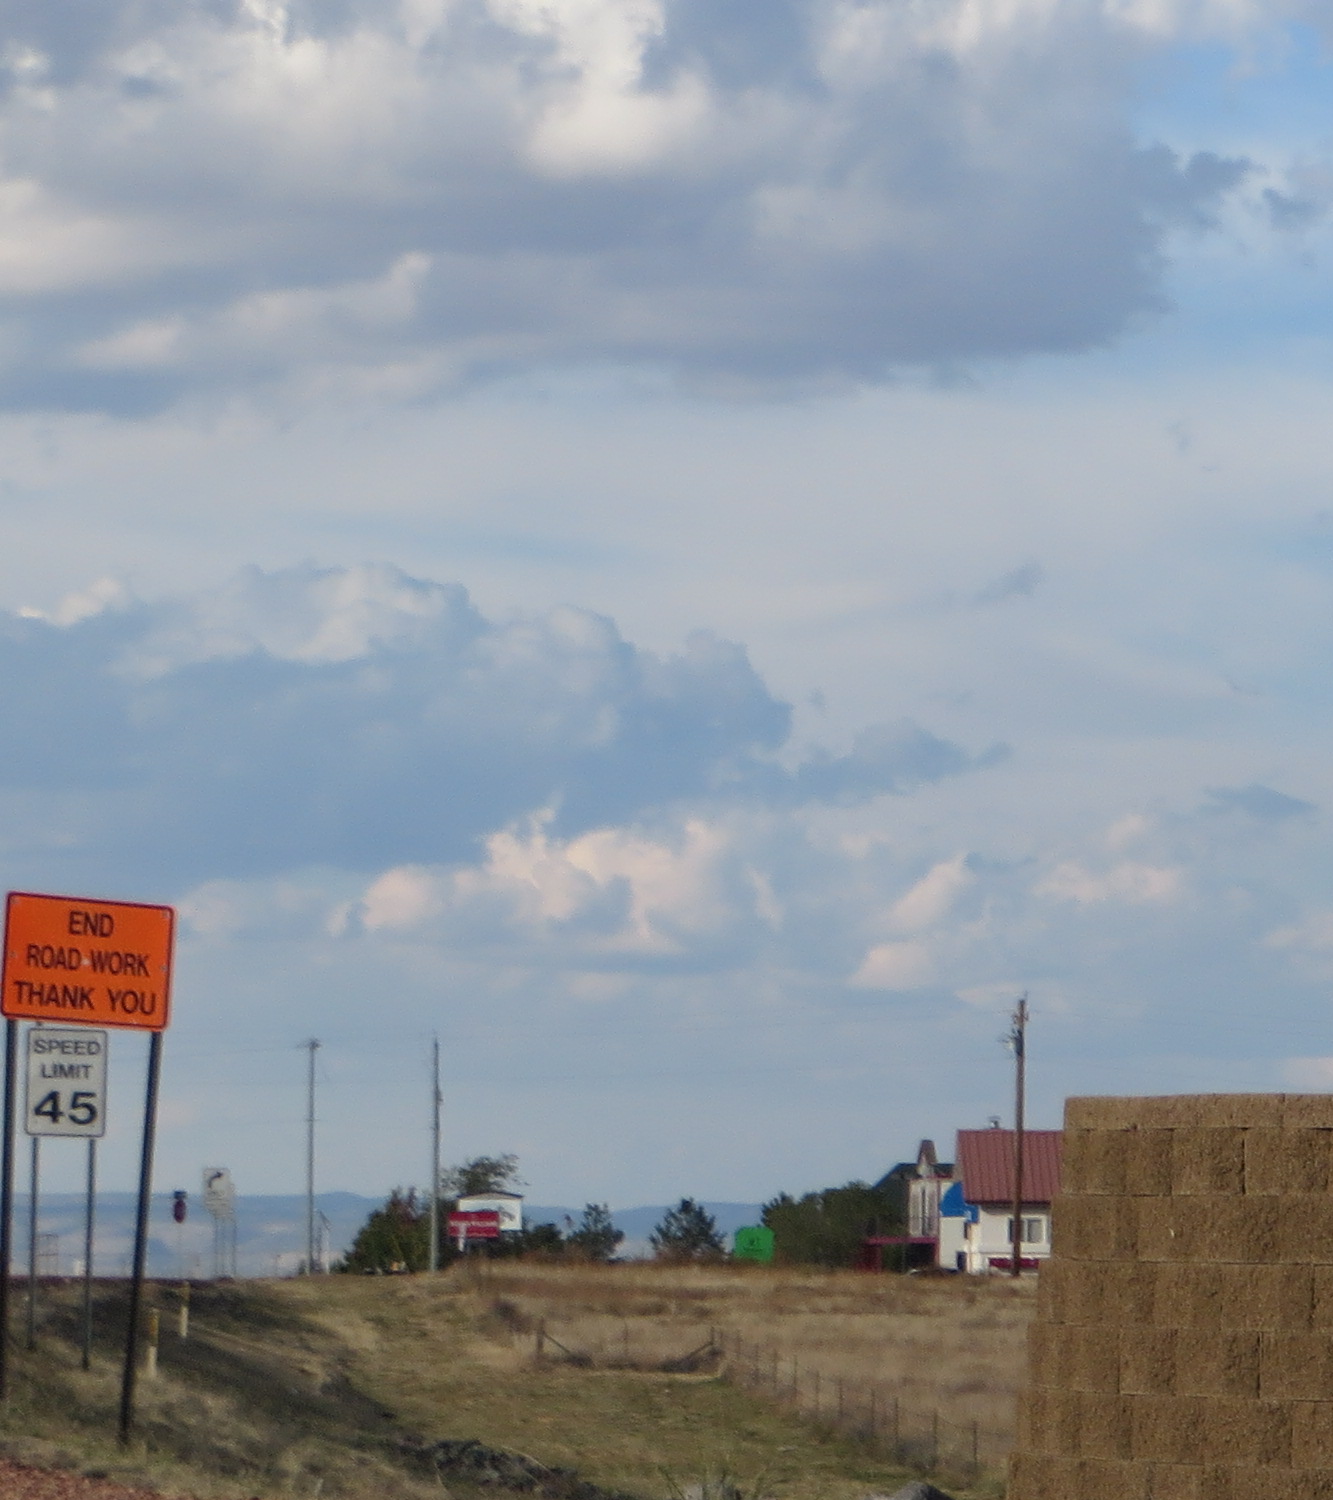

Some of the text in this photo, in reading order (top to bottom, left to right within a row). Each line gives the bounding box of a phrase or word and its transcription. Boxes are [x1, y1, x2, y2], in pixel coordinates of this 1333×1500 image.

[69, 912, 113, 937] END
[28, 945, 150, 977] ROAD WORK
[15, 981, 157, 1015] THANK YOU
[34, 1040, 100, 1055] SPEED
[41, 1064, 92, 1079] LIMIT
[35, 1091, 97, 1125] 45
